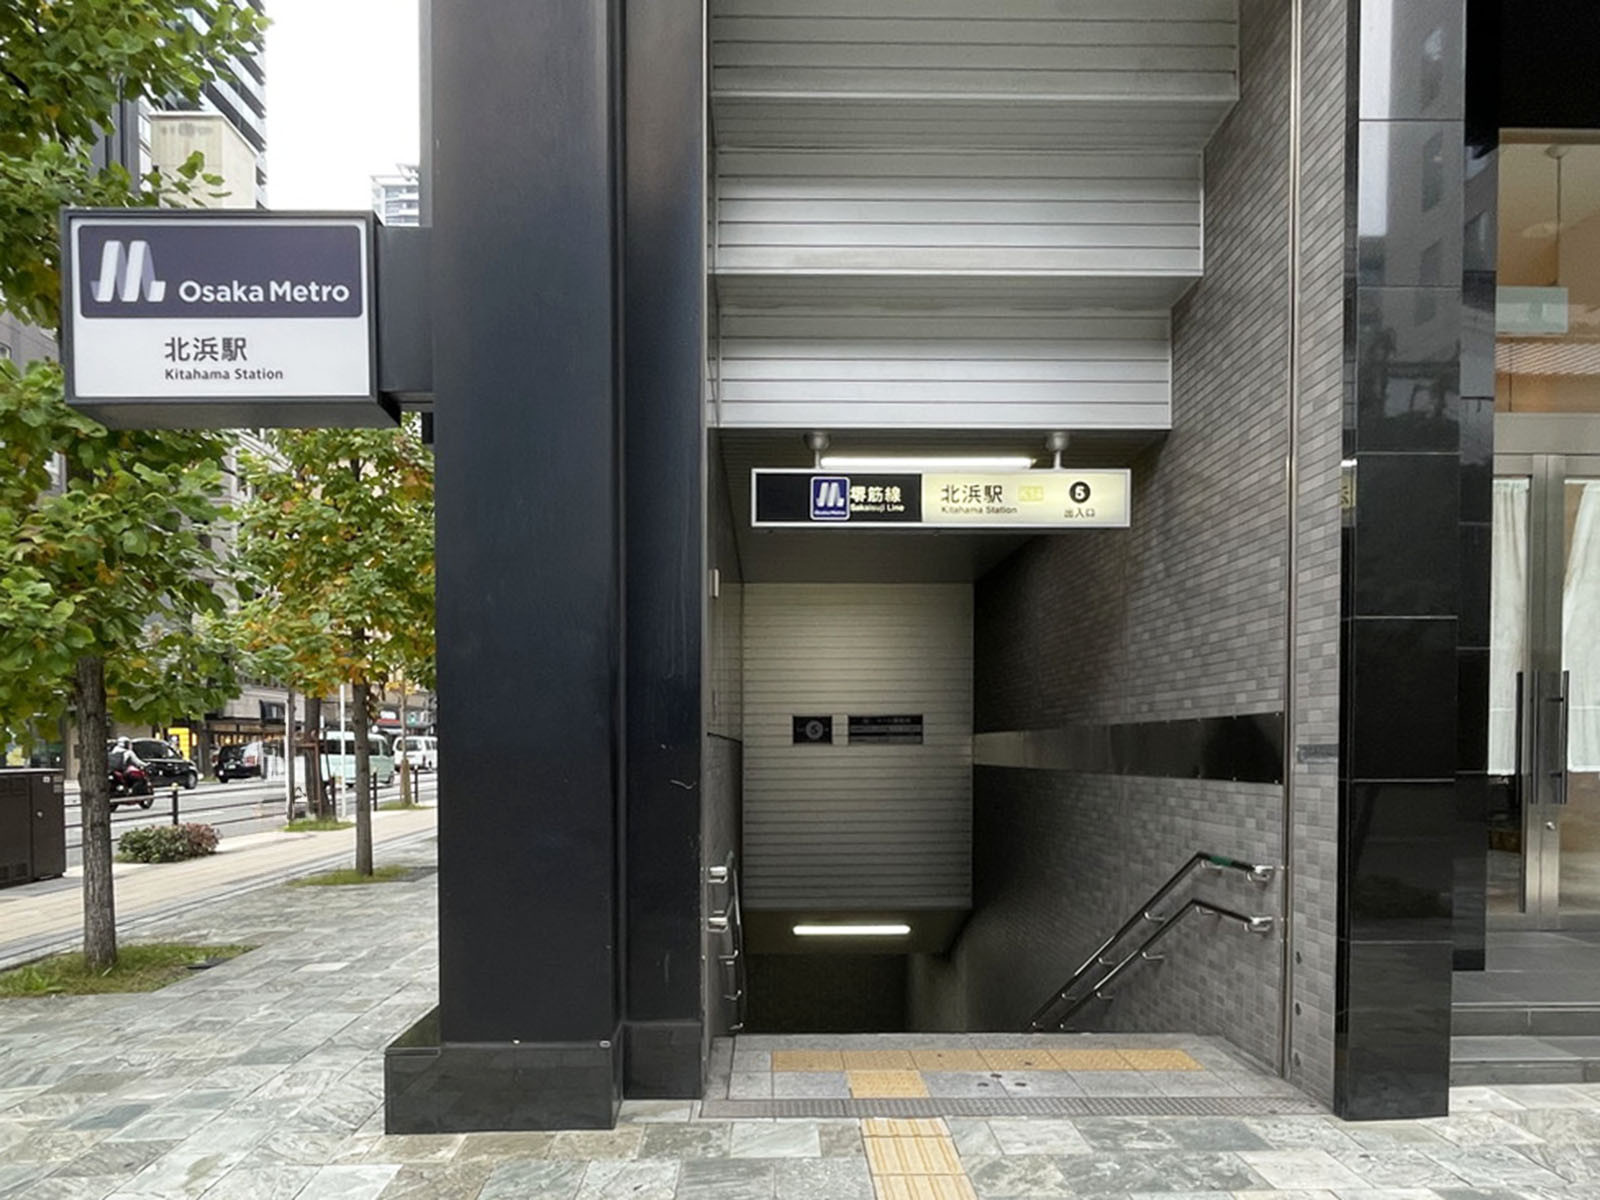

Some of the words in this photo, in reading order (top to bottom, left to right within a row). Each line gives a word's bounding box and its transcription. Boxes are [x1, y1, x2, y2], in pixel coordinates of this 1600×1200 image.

[179, 280, 264, 303] Osaka
[270, 280, 350, 304] Metro
[164, 336, 248, 362] 北浜駅
[165, 368, 231, 380] Kitahama
[234, 368, 284, 380] Station
[940, 484, 1004, 504] 北浜駅
[940, 505, 983, 514] Kitahama
[985, 505, 1018, 514] Station
[1063, 507, 1096, 519] 出入口
